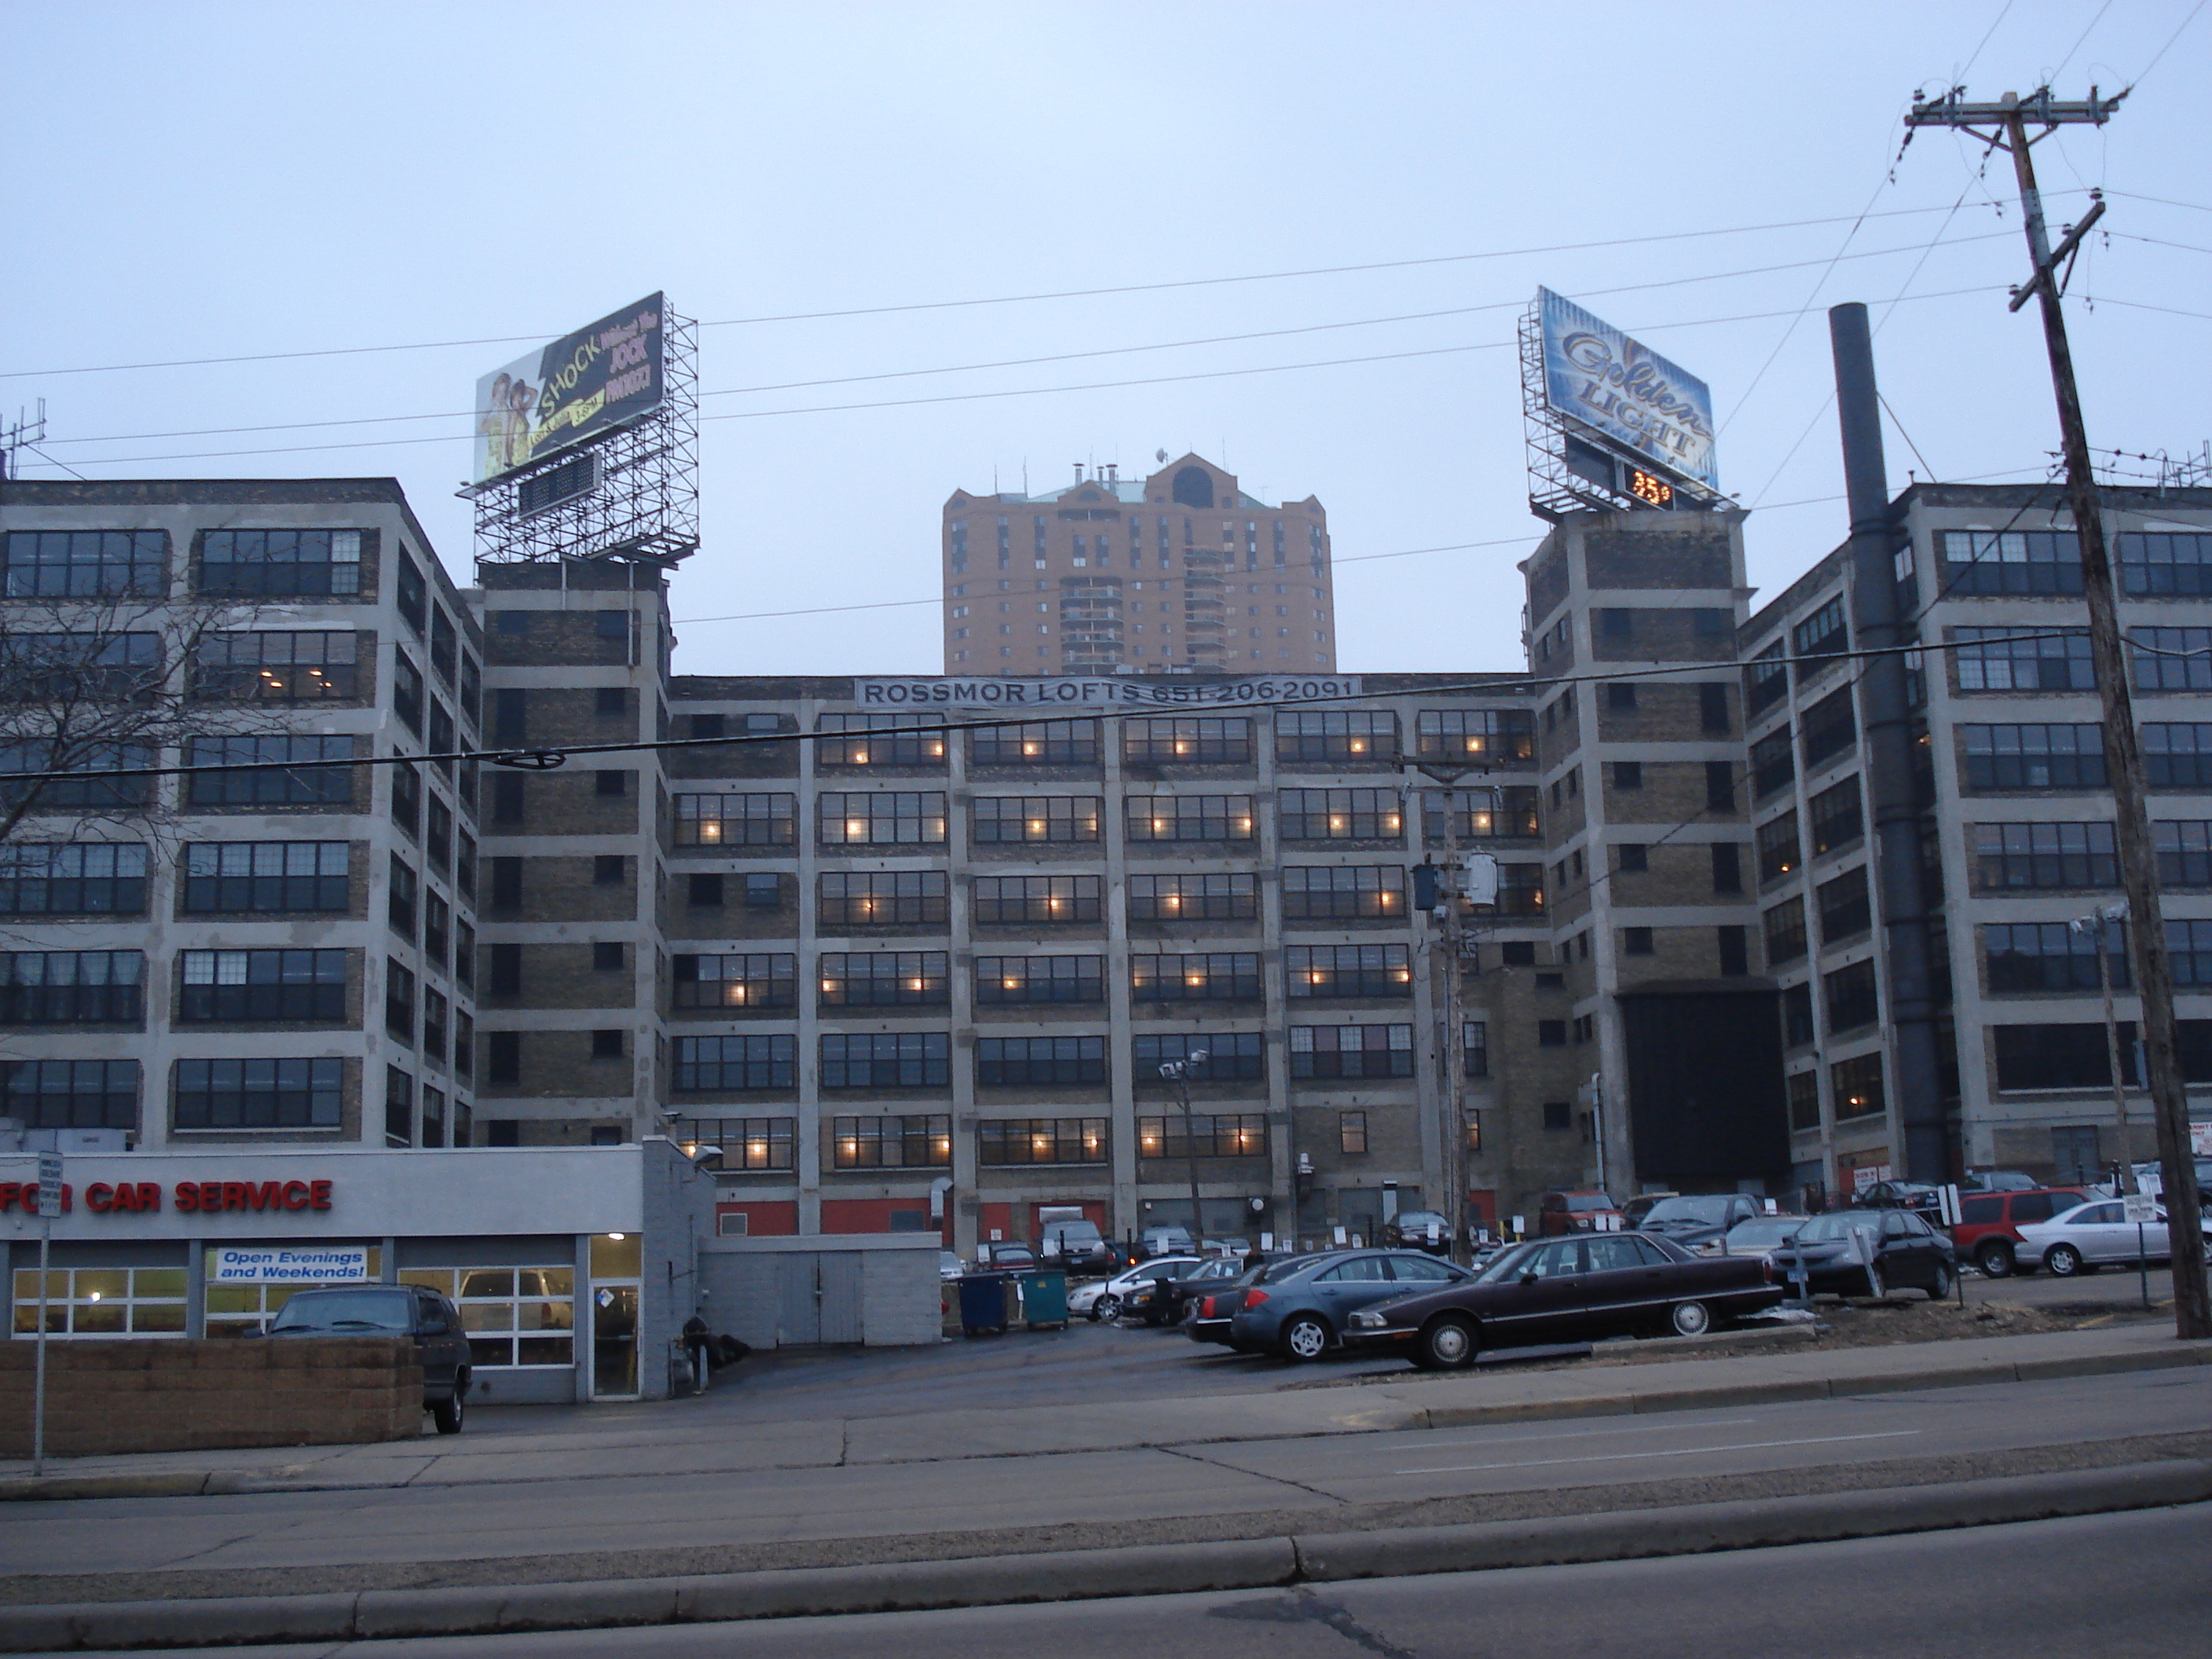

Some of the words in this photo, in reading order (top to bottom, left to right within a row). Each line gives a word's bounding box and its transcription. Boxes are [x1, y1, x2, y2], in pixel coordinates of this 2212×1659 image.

[610, 334, 648, 373] JOCK
[541, 335, 601, 417] SHOCK
[1562, 331, 1713, 441] Golden
[1578, 379, 1696, 457] LIGHT
[865, 683, 1025, 703] ROSSMOR
[1038, 682, 1139, 701] LOFTS
[86, 1181, 162, 1212] CAR
[174, 1180, 333, 1211] SERVICE
[221, 1266, 256, 1278] and
[262, 1266, 364, 1278] Weekends!
[224, 1252, 273, 1265] Open
[279, 1252, 362, 1265] Evenings
